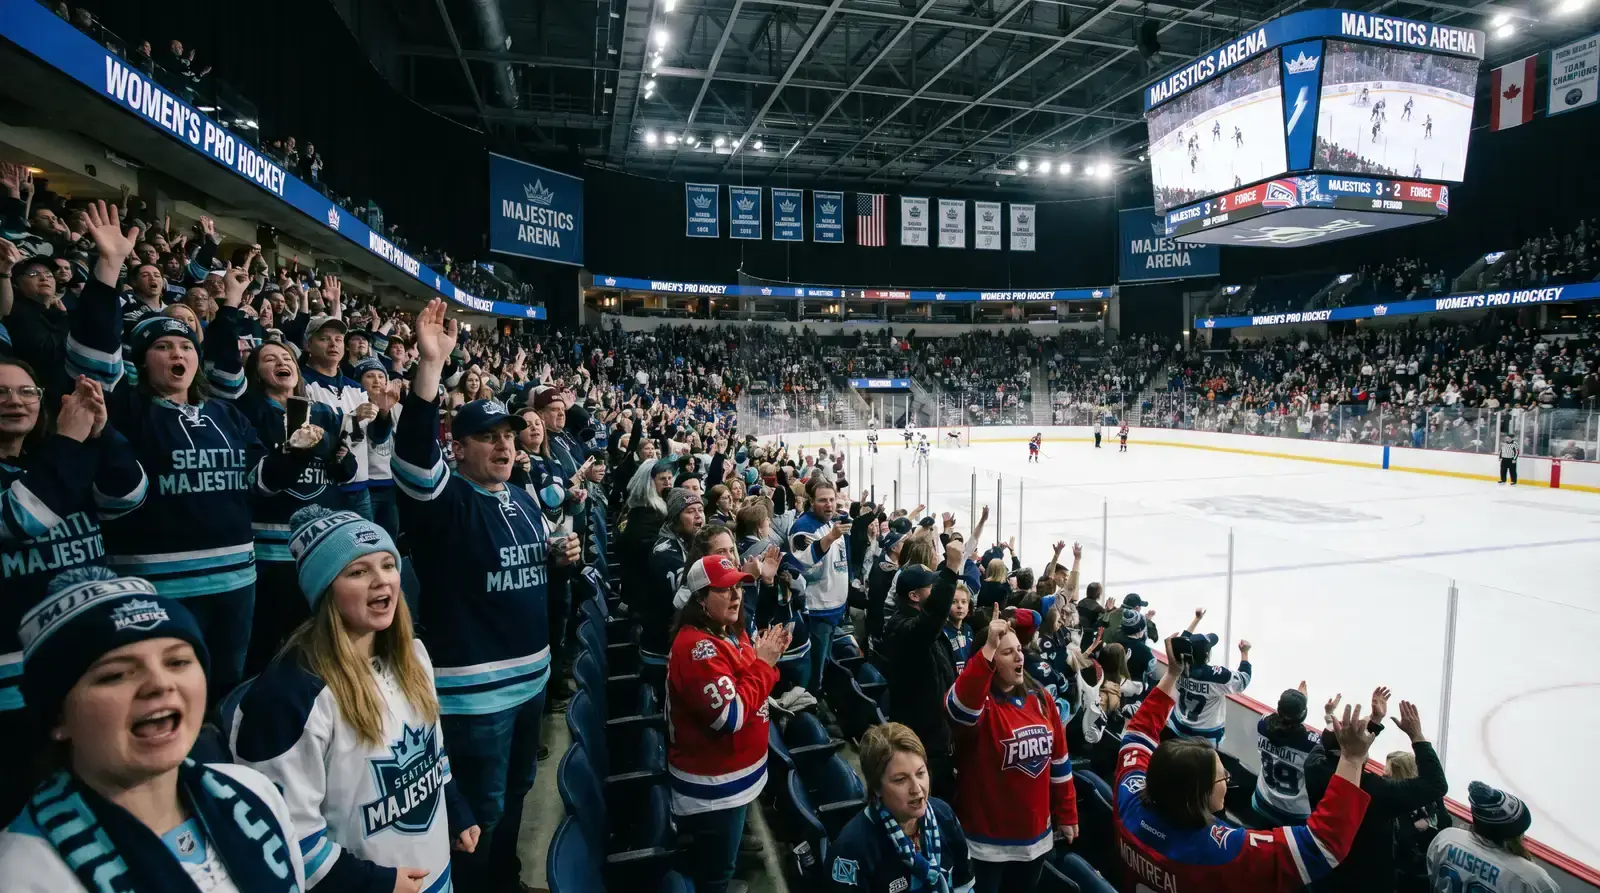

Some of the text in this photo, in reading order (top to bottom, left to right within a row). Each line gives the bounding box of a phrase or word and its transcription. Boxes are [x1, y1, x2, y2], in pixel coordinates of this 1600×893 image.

[1341, 12, 1476, 54] MAJESTICS ARENA
[1150, 27, 1268, 106] MAJESTICS ARENA
[105, 54, 286, 197] WOMEN'S PRO HOCKEY
[1328, 179, 1371, 194] MAJESTICS
[1375, 182, 1383, 196] 3
[1393, 183, 1401, 197] 2
[1410, 186, 1433, 199] FORCE
[502, 199, 574, 231] MAJESTICS
[1170, 206, 1201, 224] MAJESTICS
[1204, 202, 1211, 215] 3
[1220, 197, 1227, 211] 2
[1234, 189, 1257, 206] FORCE
[517, 223, 561, 248] ARENA
[1145, 251, 1192, 270] ARENA
[651, 281, 727, 294] WOMEN'S PRO HOCKEY
[981, 291, 1055, 300] WOMEN'S PRO HOCKEY
[1435, 287, 1564, 311] WOMEN'S PRO HOCKEY
[1252, 309, 1333, 326] WOMEN'S PRO HOCKEY
[171, 449, 247, 470] SEATTLE
[158, 470, 248, 496] MAJESTIC
[500, 542, 548, 568] SEATTL
[703, 675, 737, 710] 33
[1178, 687, 1207, 722] 17
[1007, 735, 1053, 765] FORCE
[394, 754, 435, 789] SEATTLE
[1447, 843, 1501, 888] MUSFER
